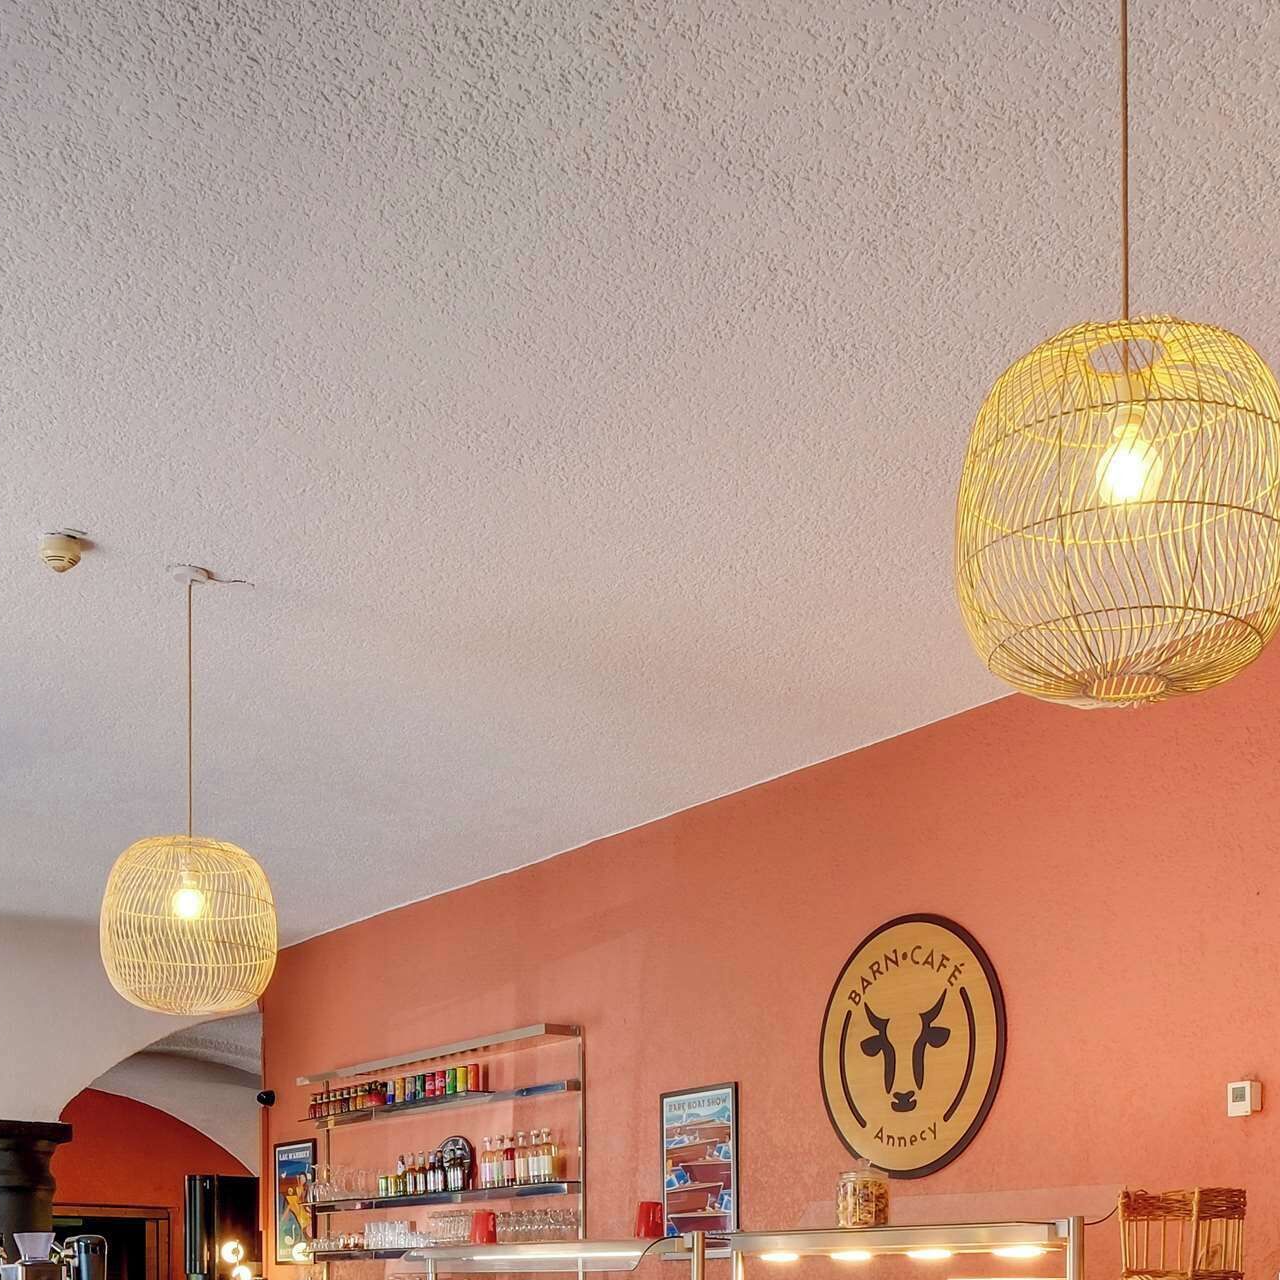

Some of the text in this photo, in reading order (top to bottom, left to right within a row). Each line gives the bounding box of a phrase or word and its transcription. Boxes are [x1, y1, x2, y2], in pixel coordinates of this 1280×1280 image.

[847, 945, 966, 1007] BARN CAFÉ
[707, 1096, 727, 1106] SHOW
[873, 1121, 938, 1148] Annecy
